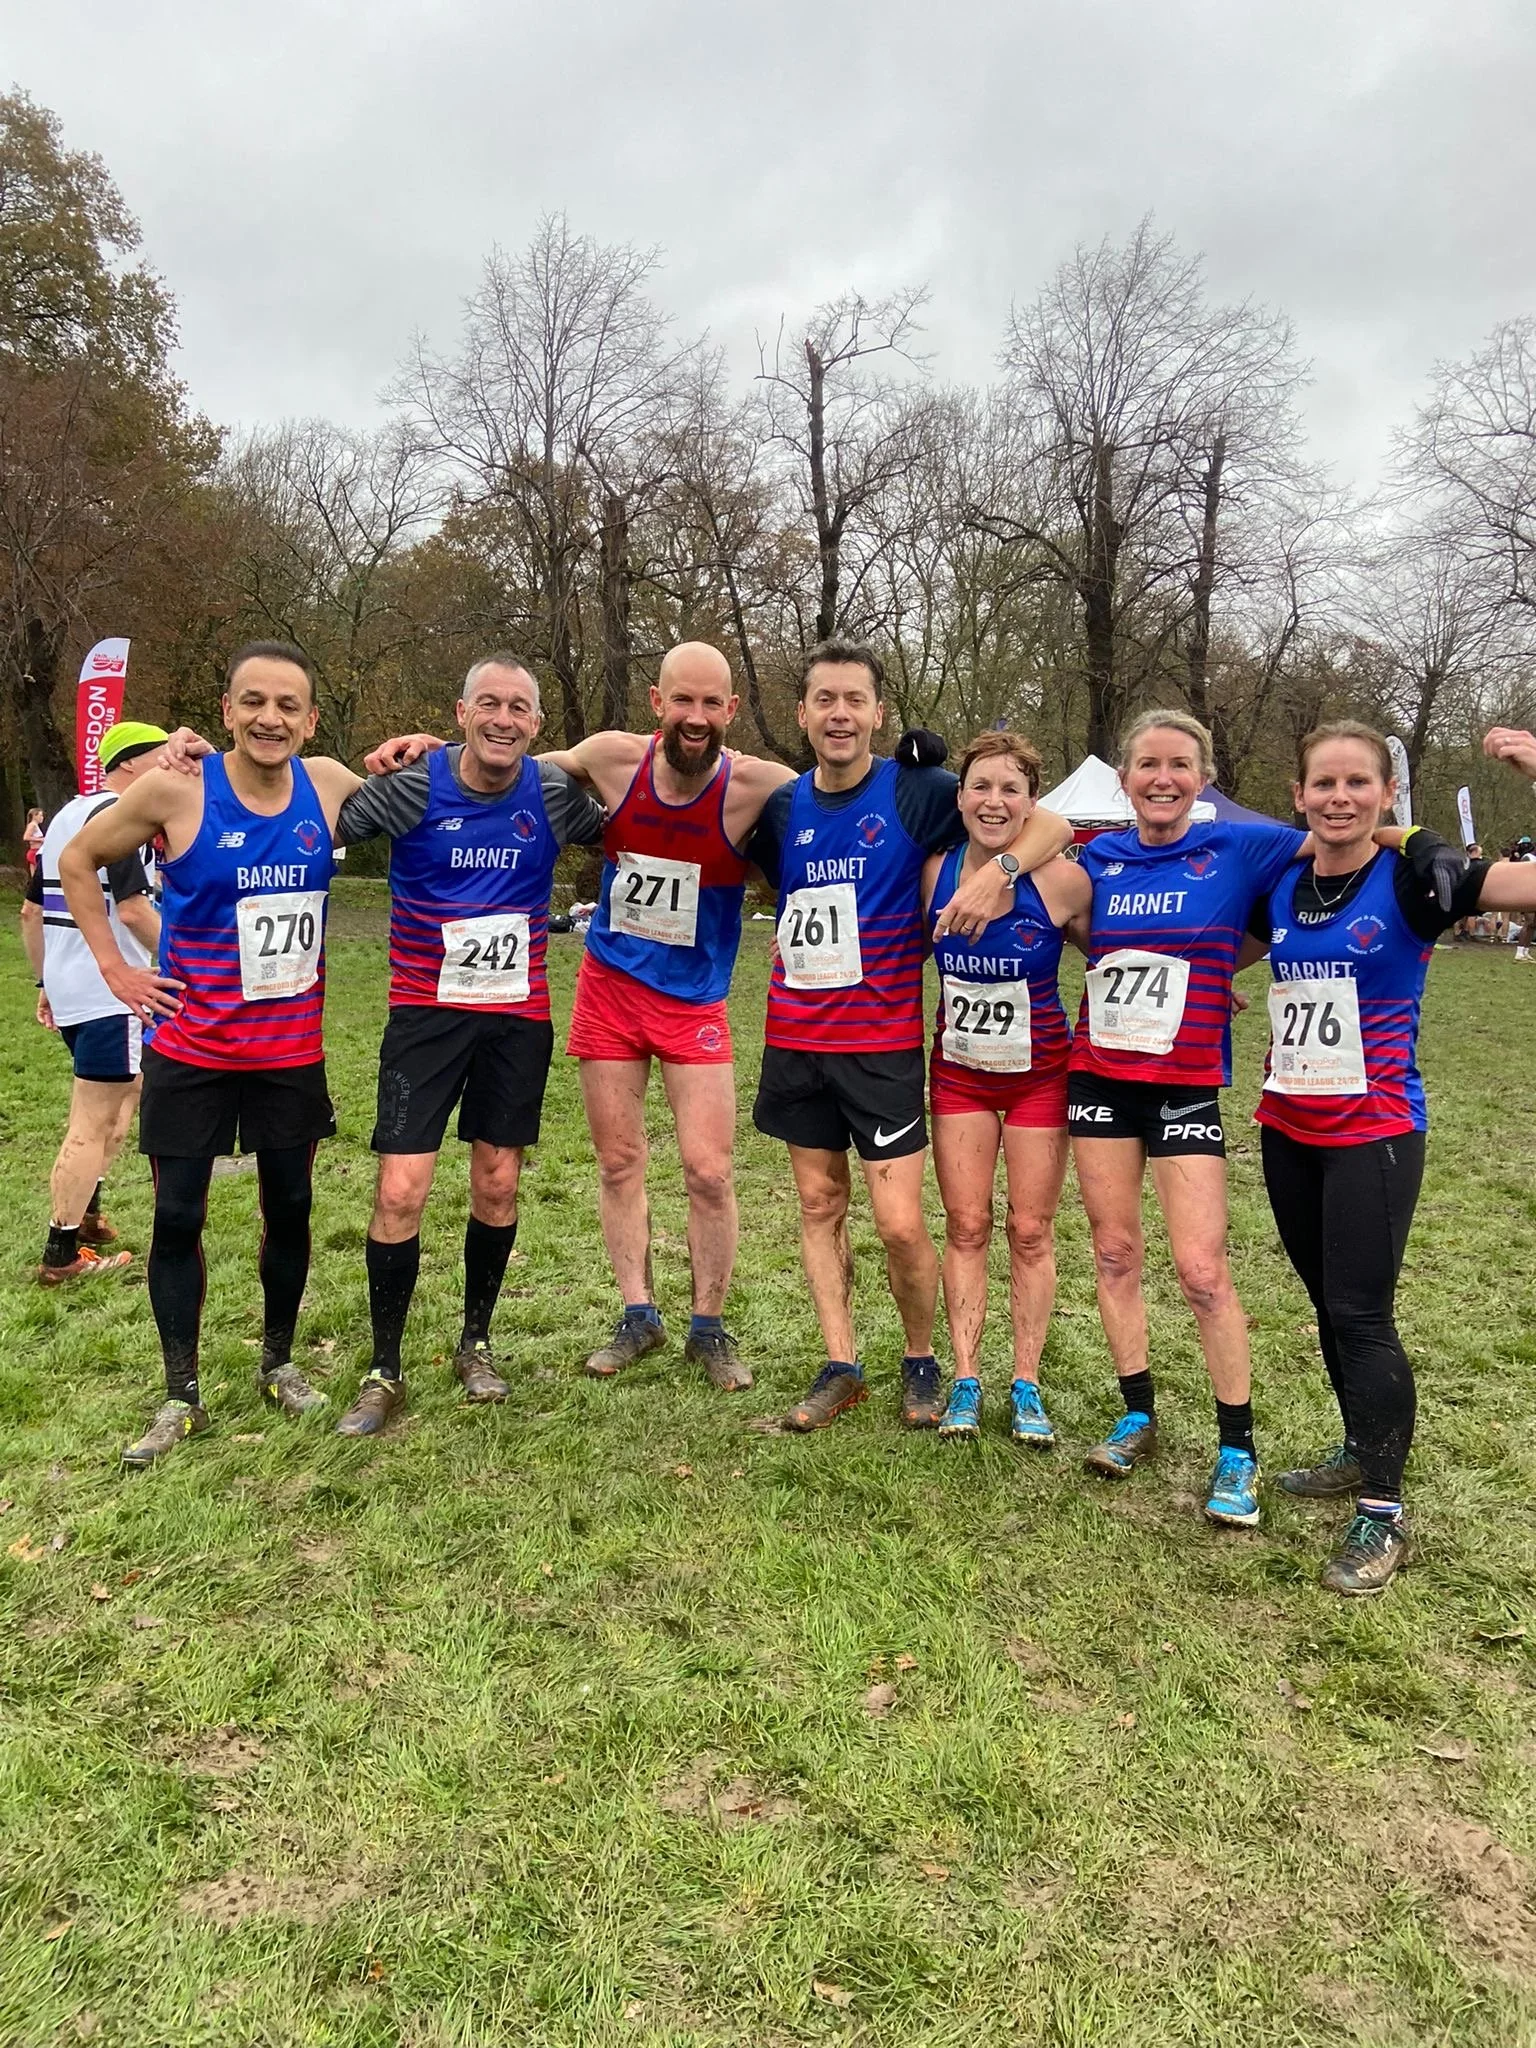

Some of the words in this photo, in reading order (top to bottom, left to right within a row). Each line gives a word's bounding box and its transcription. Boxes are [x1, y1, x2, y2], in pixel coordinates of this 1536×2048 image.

[450, 847, 522, 870] BARNET
[806, 857, 867, 883] BARNET
[237, 864, 308, 890] BARNET
[624, 872, 680, 912] 271
[1107, 891, 1188, 916] BARNET
[254, 911, 315, 957] 270
[788, 905, 839, 947] 261
[458, 933, 519, 971] 242
[944, 952, 1023, 977] BARNET
[1278, 961, 1354, 981] BARNET
[1102, 966, 1169, 1009] 274
[952, 995, 1015, 1036] 229
[1281, 1002, 1341, 1047] 276
[1162, 1123, 1223, 1142] PRO
